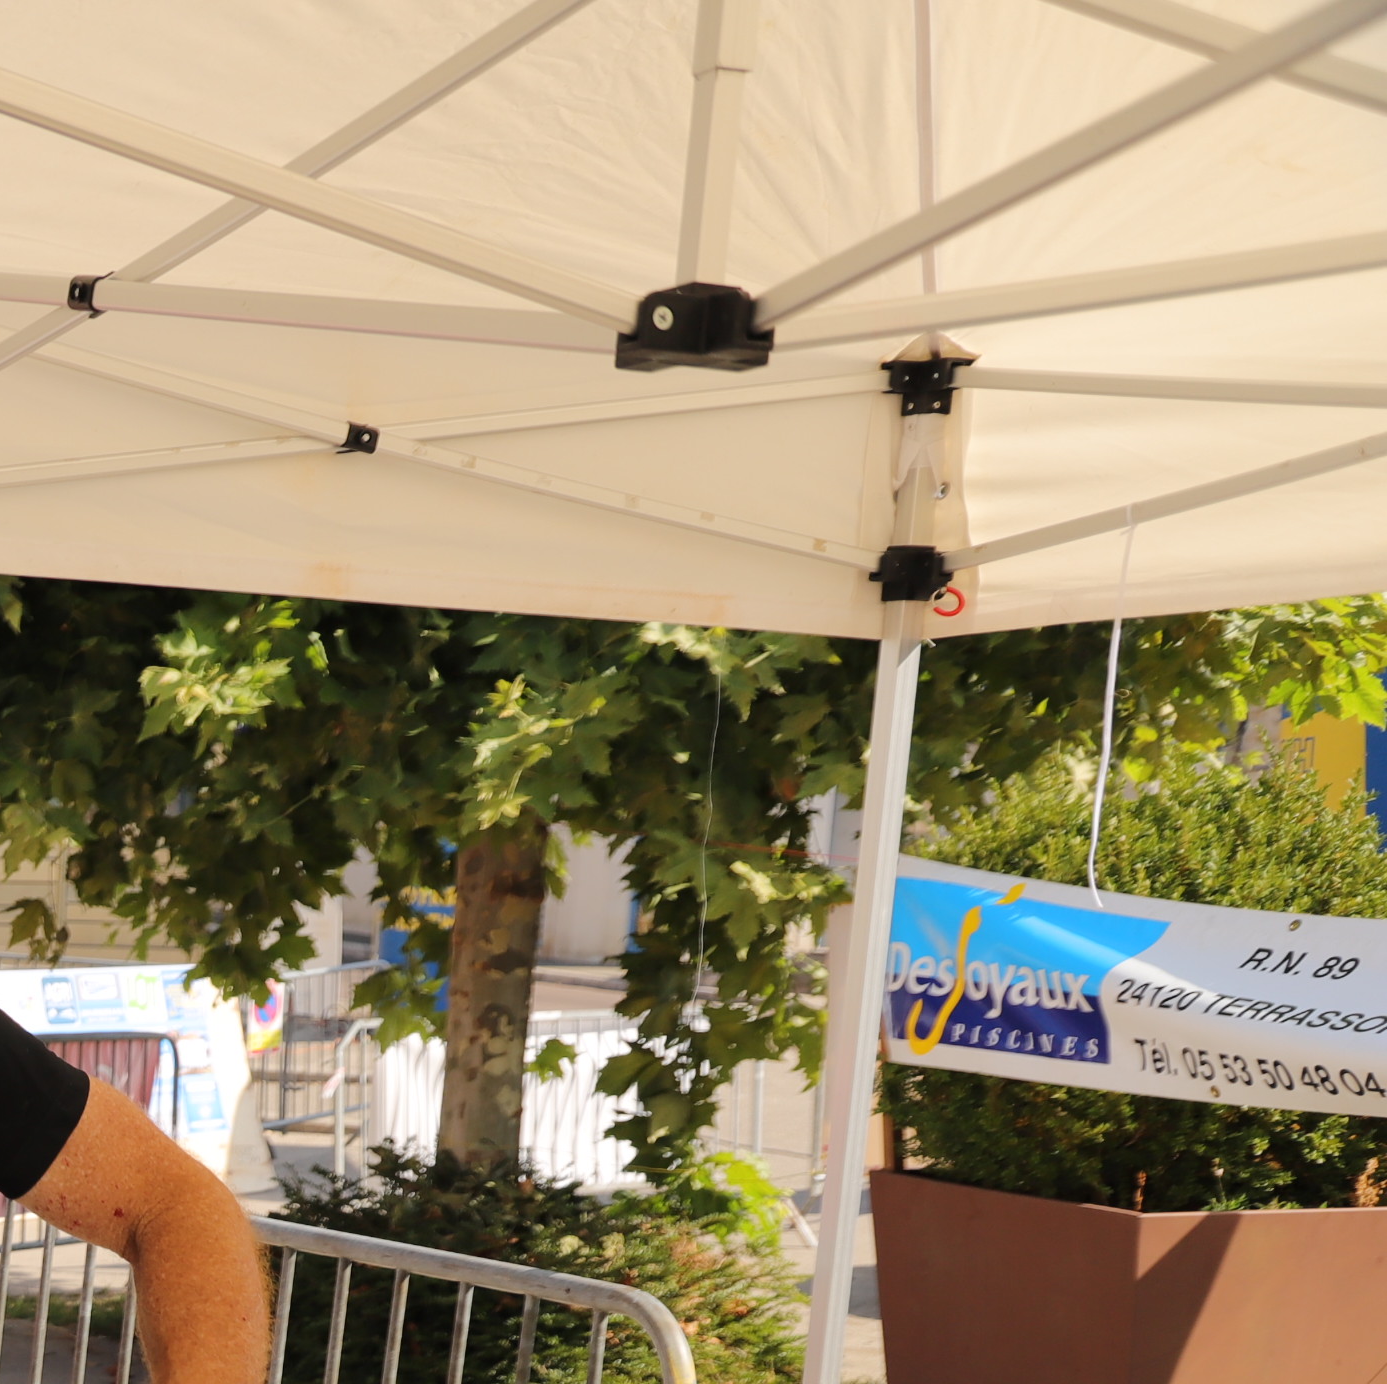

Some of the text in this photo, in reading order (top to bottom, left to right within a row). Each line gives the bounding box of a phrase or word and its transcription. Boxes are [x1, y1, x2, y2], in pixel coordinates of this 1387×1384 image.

[1238, 947, 1360, 980] R.N. 89
[1116, 978, 1203, 1011] 24120
[951, 1022, 1100, 1059] PISCINES
[1133, 1037, 1178, 1075] Tél.
[1182, 1046, 1216, 1082] 05
[1219, 1052, 1253, 1087] 53
[1256, 1058, 1295, 1092] 50
[1300, 1064, 1339, 1095] 48
